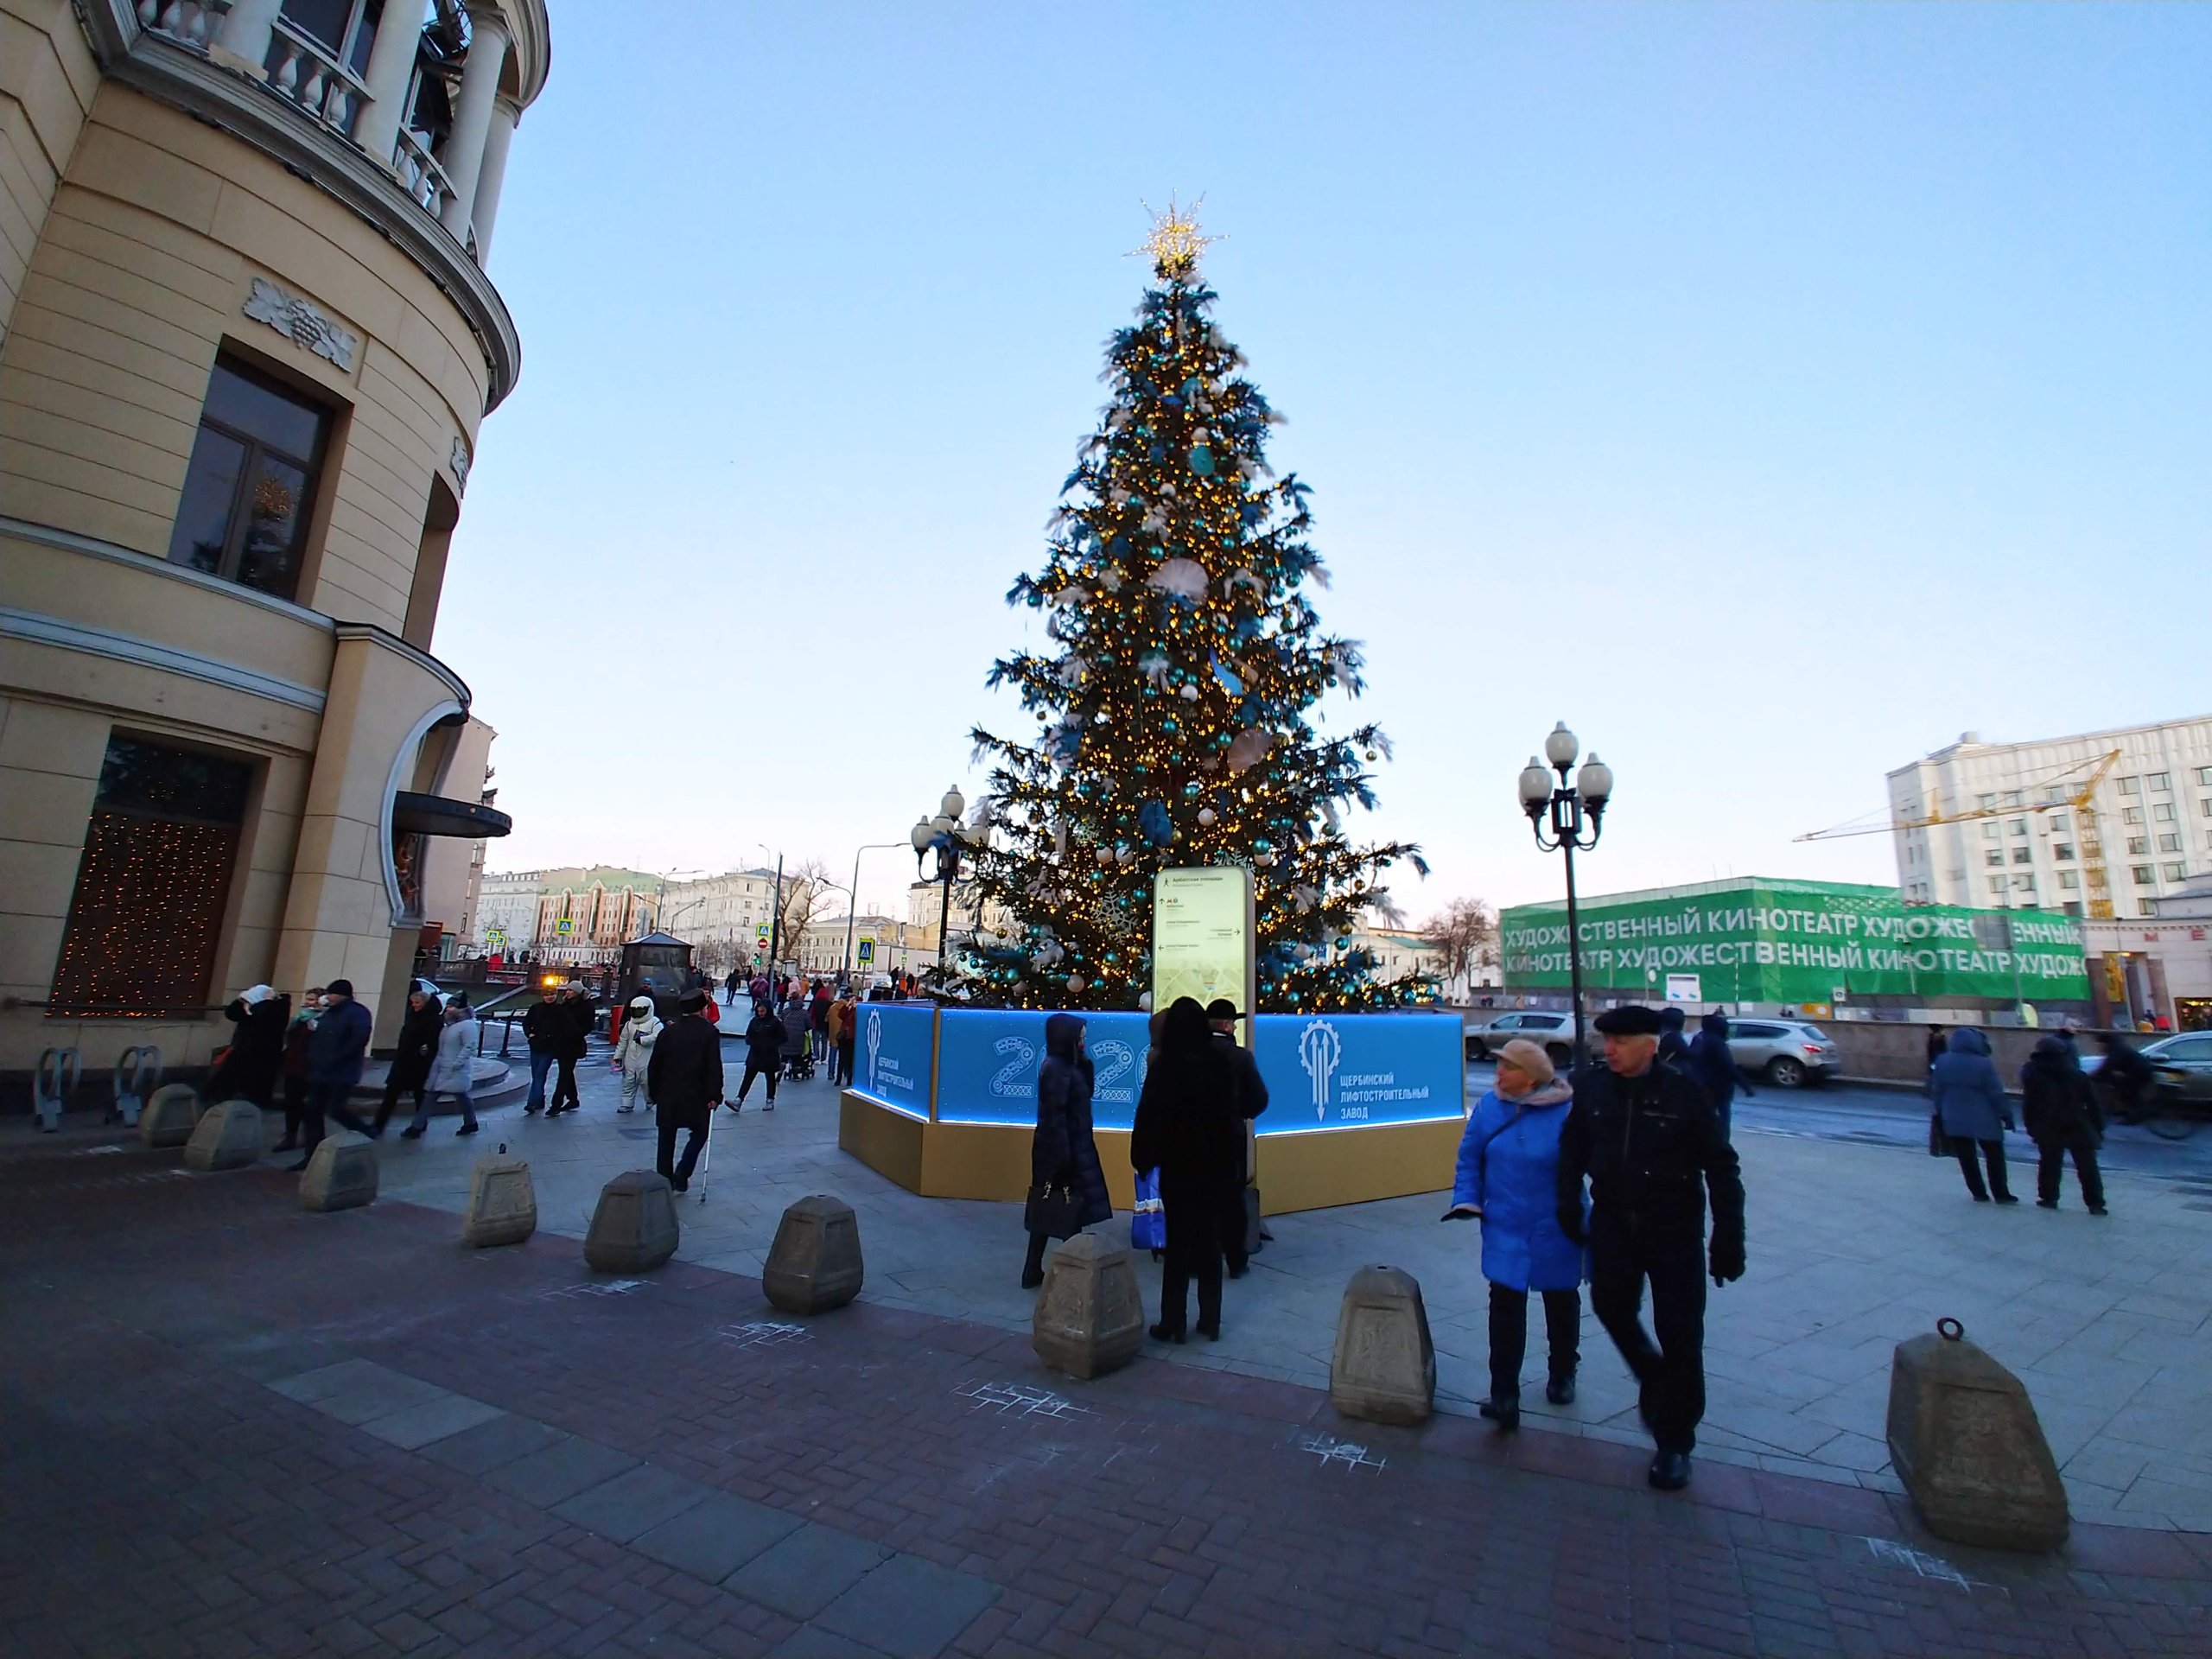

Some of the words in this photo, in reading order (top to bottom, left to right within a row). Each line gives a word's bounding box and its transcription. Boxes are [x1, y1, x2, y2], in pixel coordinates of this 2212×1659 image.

[1505, 906, 1700, 949] ХУДОЖСТВЕННЫЙ
[1707, 907, 1859, 936] КИНОТЕАТР
[1617, 940, 1864, 971] ХУДОЖЕСТВЕННЫЙ
[1867, 949, 2012, 973] КИНОТЕАТР
[1340, 1072, 1394, 1088] ЩЕРБИНСКИЙ
[1340, 1086, 1429, 1103] ЛИФТОСТРОИТЕЛЬНЫЙ
[1341, 1107, 1369, 1120] ЗАВОД
